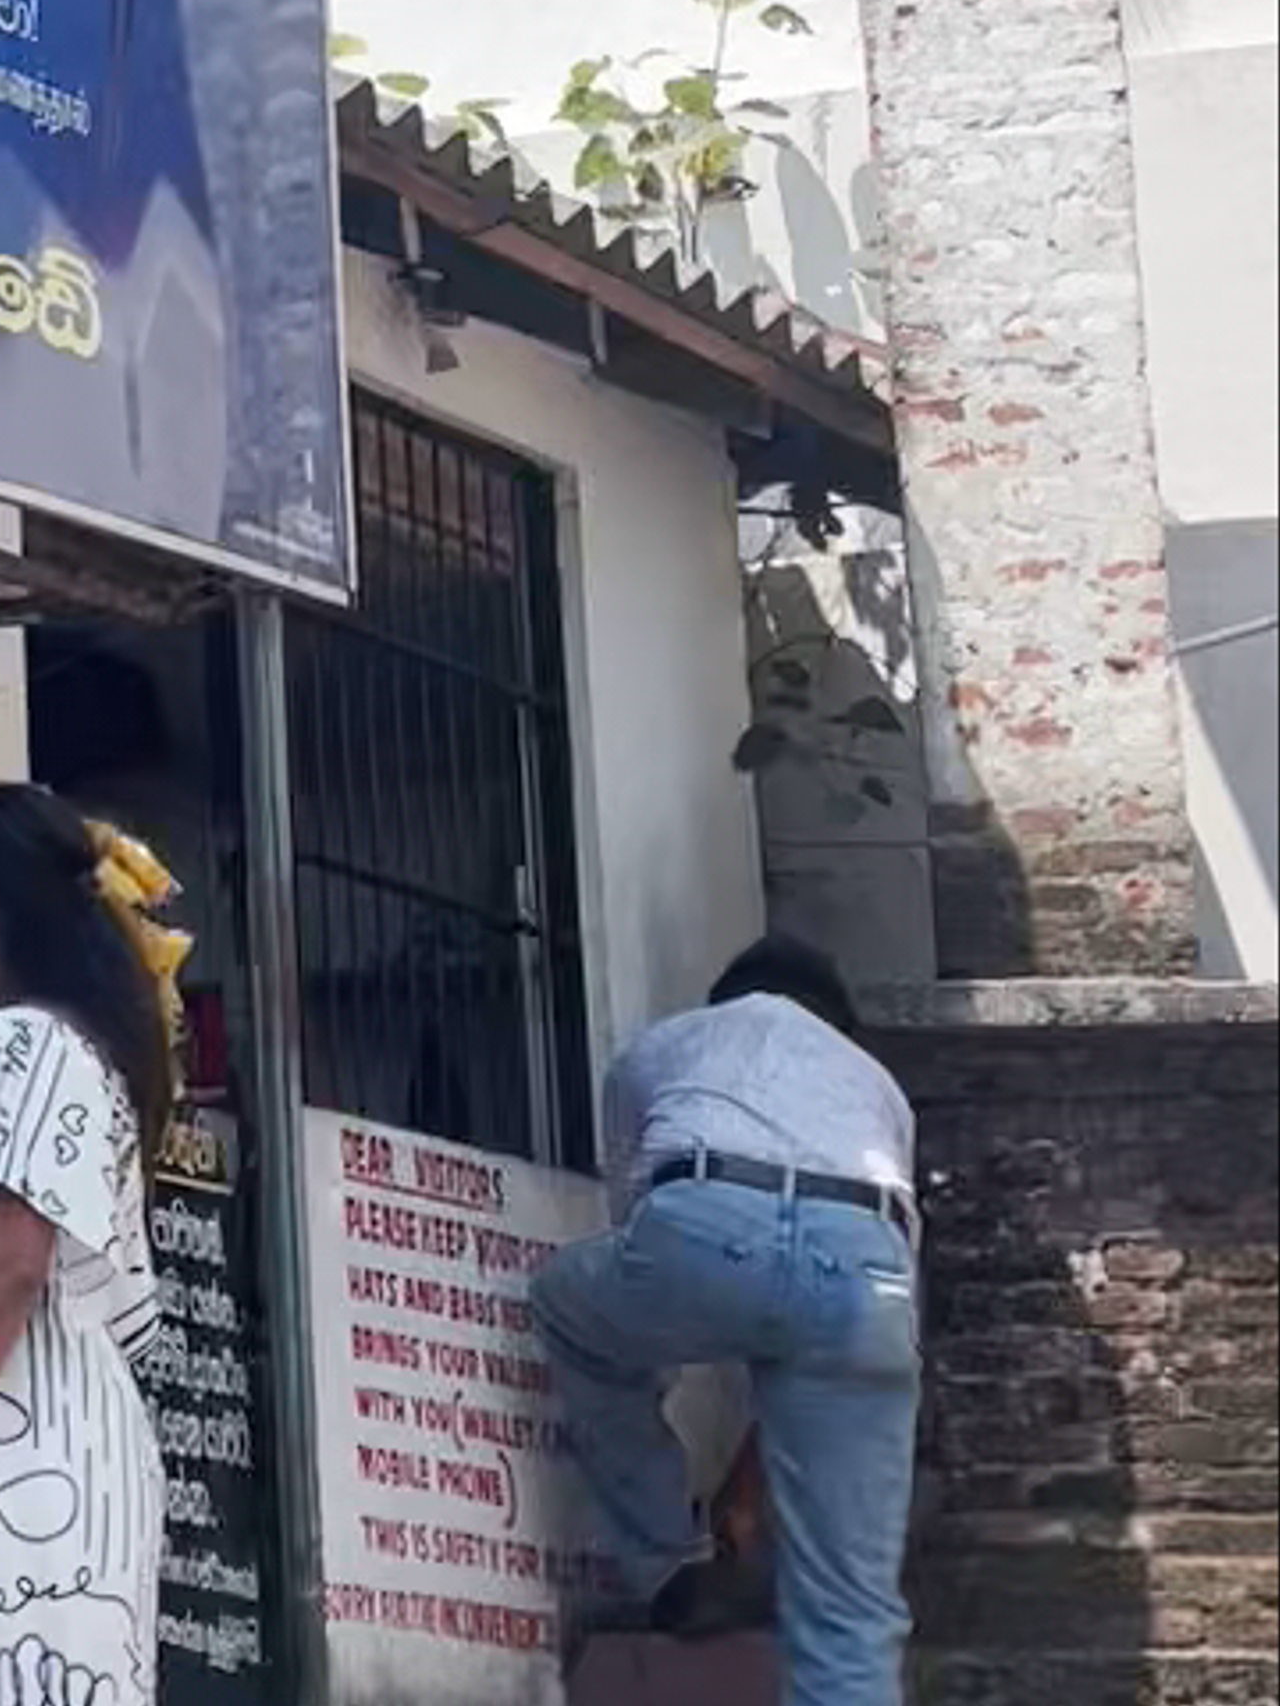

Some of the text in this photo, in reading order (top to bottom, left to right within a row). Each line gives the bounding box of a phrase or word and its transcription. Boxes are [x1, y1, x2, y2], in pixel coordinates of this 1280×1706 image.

[340, 1128, 507, 1212] DEAR VISITORS
[345, 1195, 416, 1251] PLEASE
[419, 1214, 466, 1260] KEEP
[347, 1265, 398, 1307] HATS
[404, 1277, 444, 1315] AND
[425, 1340, 479, 1379] YOUR
[354, 1386, 406, 1425] WITH
[356, 1443, 431, 1492] MOBILE
[360, 1515, 409, 1560] THIS
[411, 1522, 430, 1563] IS
